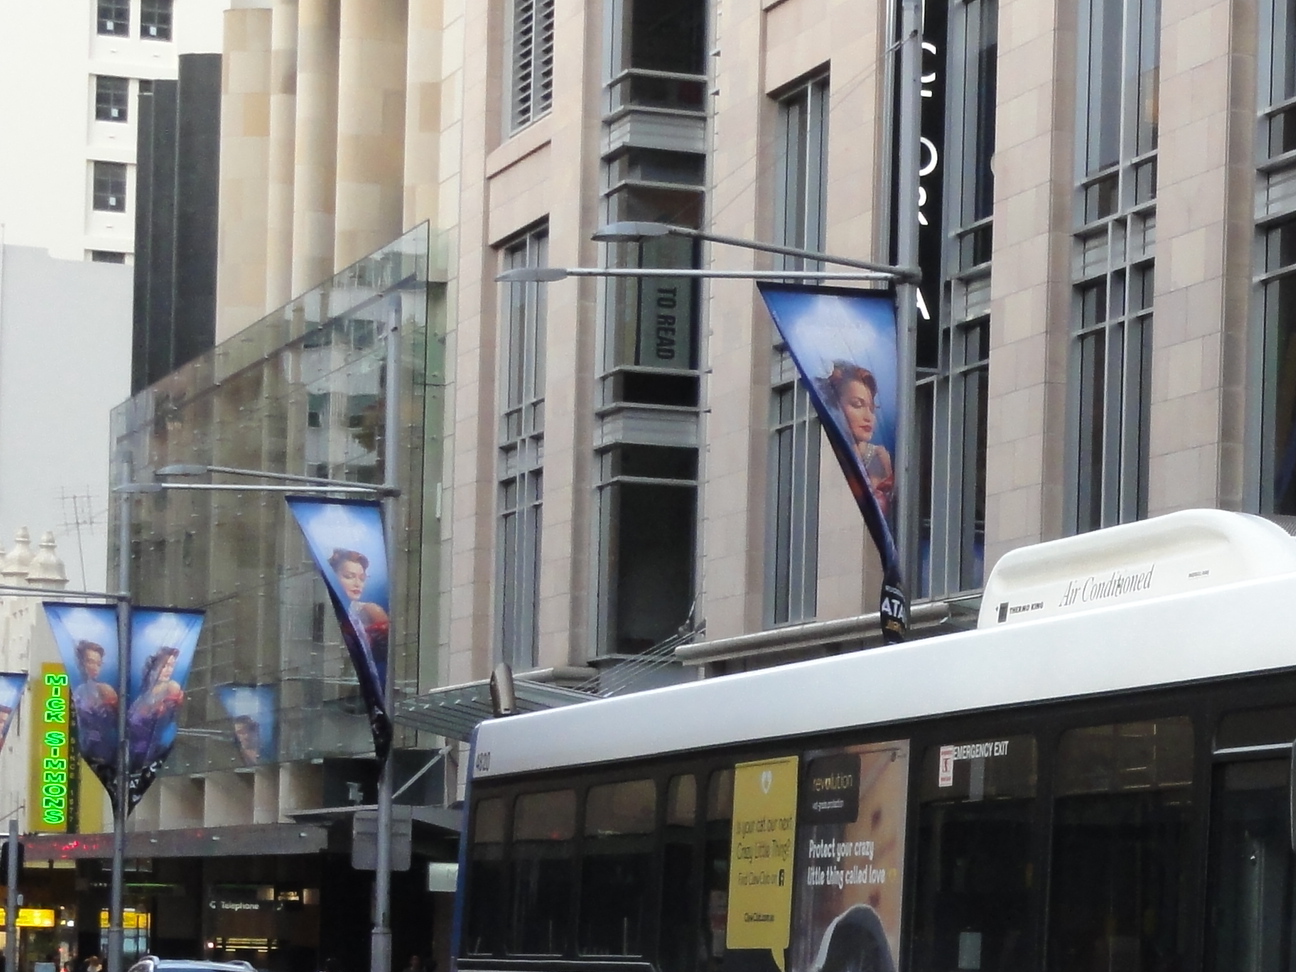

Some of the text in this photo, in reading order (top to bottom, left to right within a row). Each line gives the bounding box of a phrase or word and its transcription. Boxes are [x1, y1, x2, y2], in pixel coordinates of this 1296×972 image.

[656, 287, 677, 359] TO READ
[1059, 564, 1155, 607] Air Conditioned
[1031, 602, 1044, 611] KING
[44, 674, 68, 723] MICK
[953, 741, 1009, 760] EMERGENCY EXIT
[42, 731, 67, 825] SIMMONS
[809, 838, 875, 862] Protect your crazy
[807, 865, 886, 889] little thing called love
